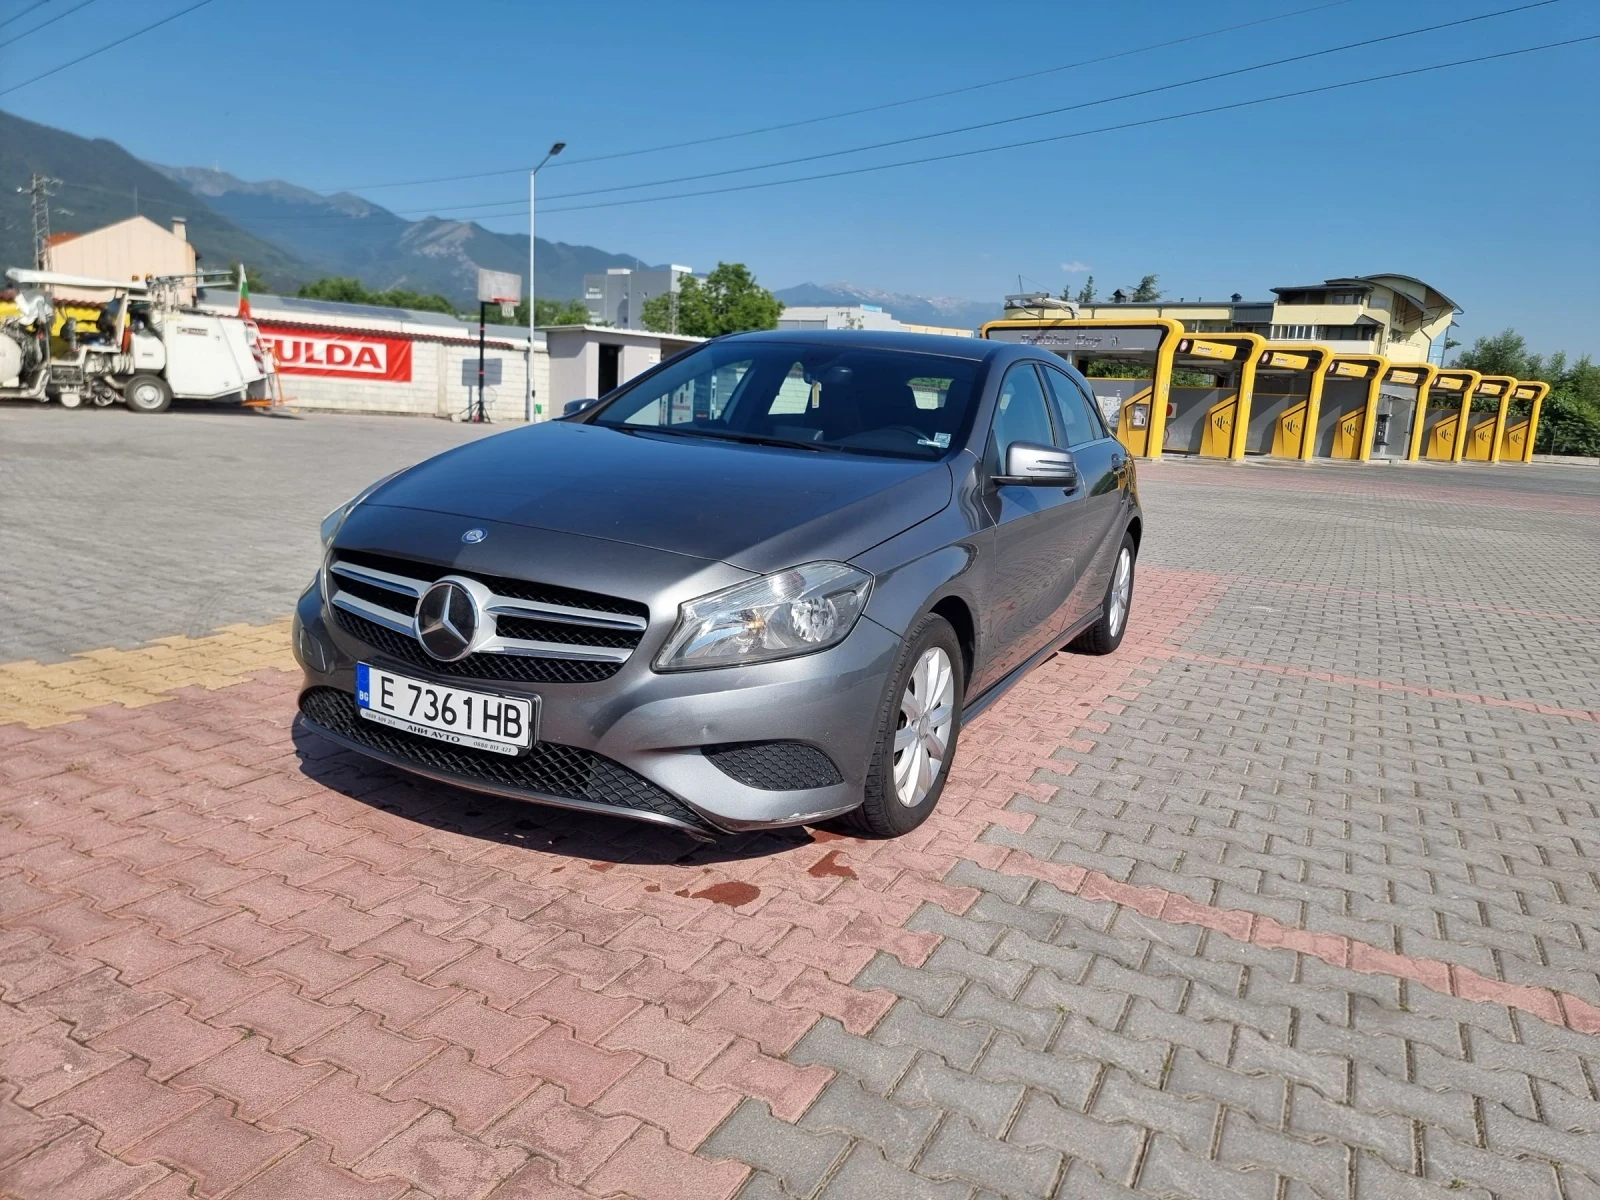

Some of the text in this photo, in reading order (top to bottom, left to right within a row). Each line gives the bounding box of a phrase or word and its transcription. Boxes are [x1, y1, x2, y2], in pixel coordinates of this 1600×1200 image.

[1075, 334, 1102, 348] Bay
[359, 690, 369, 702] BG
[381, 676, 522, 739] E 7361 HB
